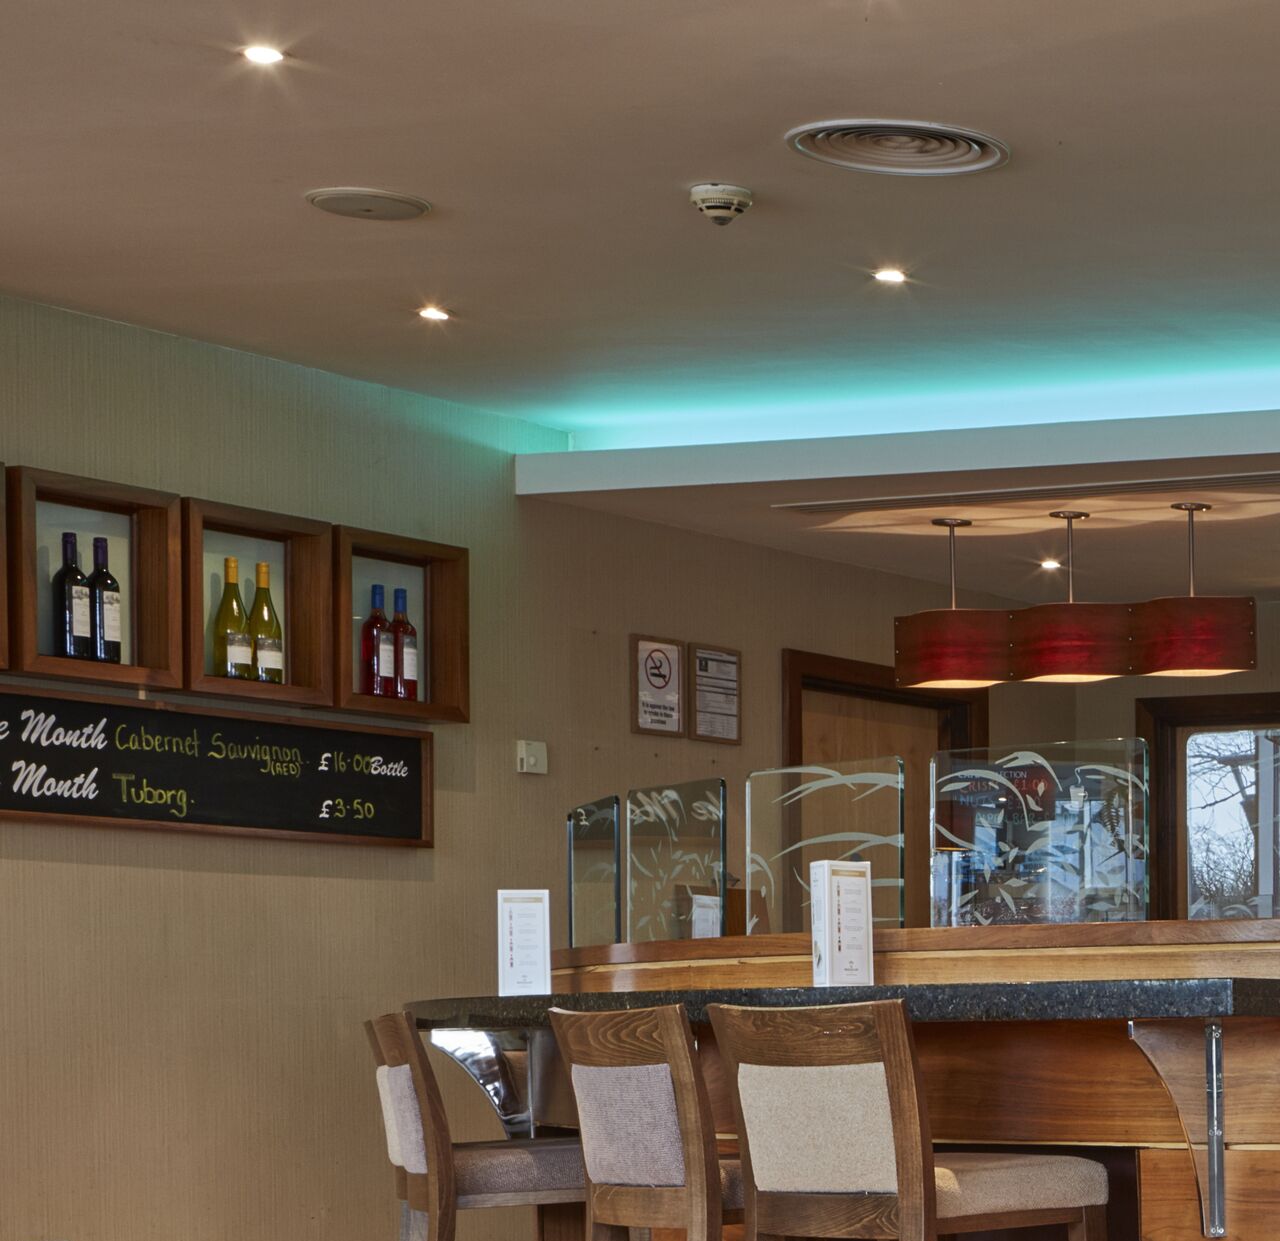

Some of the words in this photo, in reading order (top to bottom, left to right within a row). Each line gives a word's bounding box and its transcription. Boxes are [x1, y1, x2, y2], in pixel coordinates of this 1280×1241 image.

[20, 709, 108, 750] Month
[115, 724, 200, 757] Cabernet
[11, 760, 99, 800] Month
[370, 756, 409, 777] Bottle
